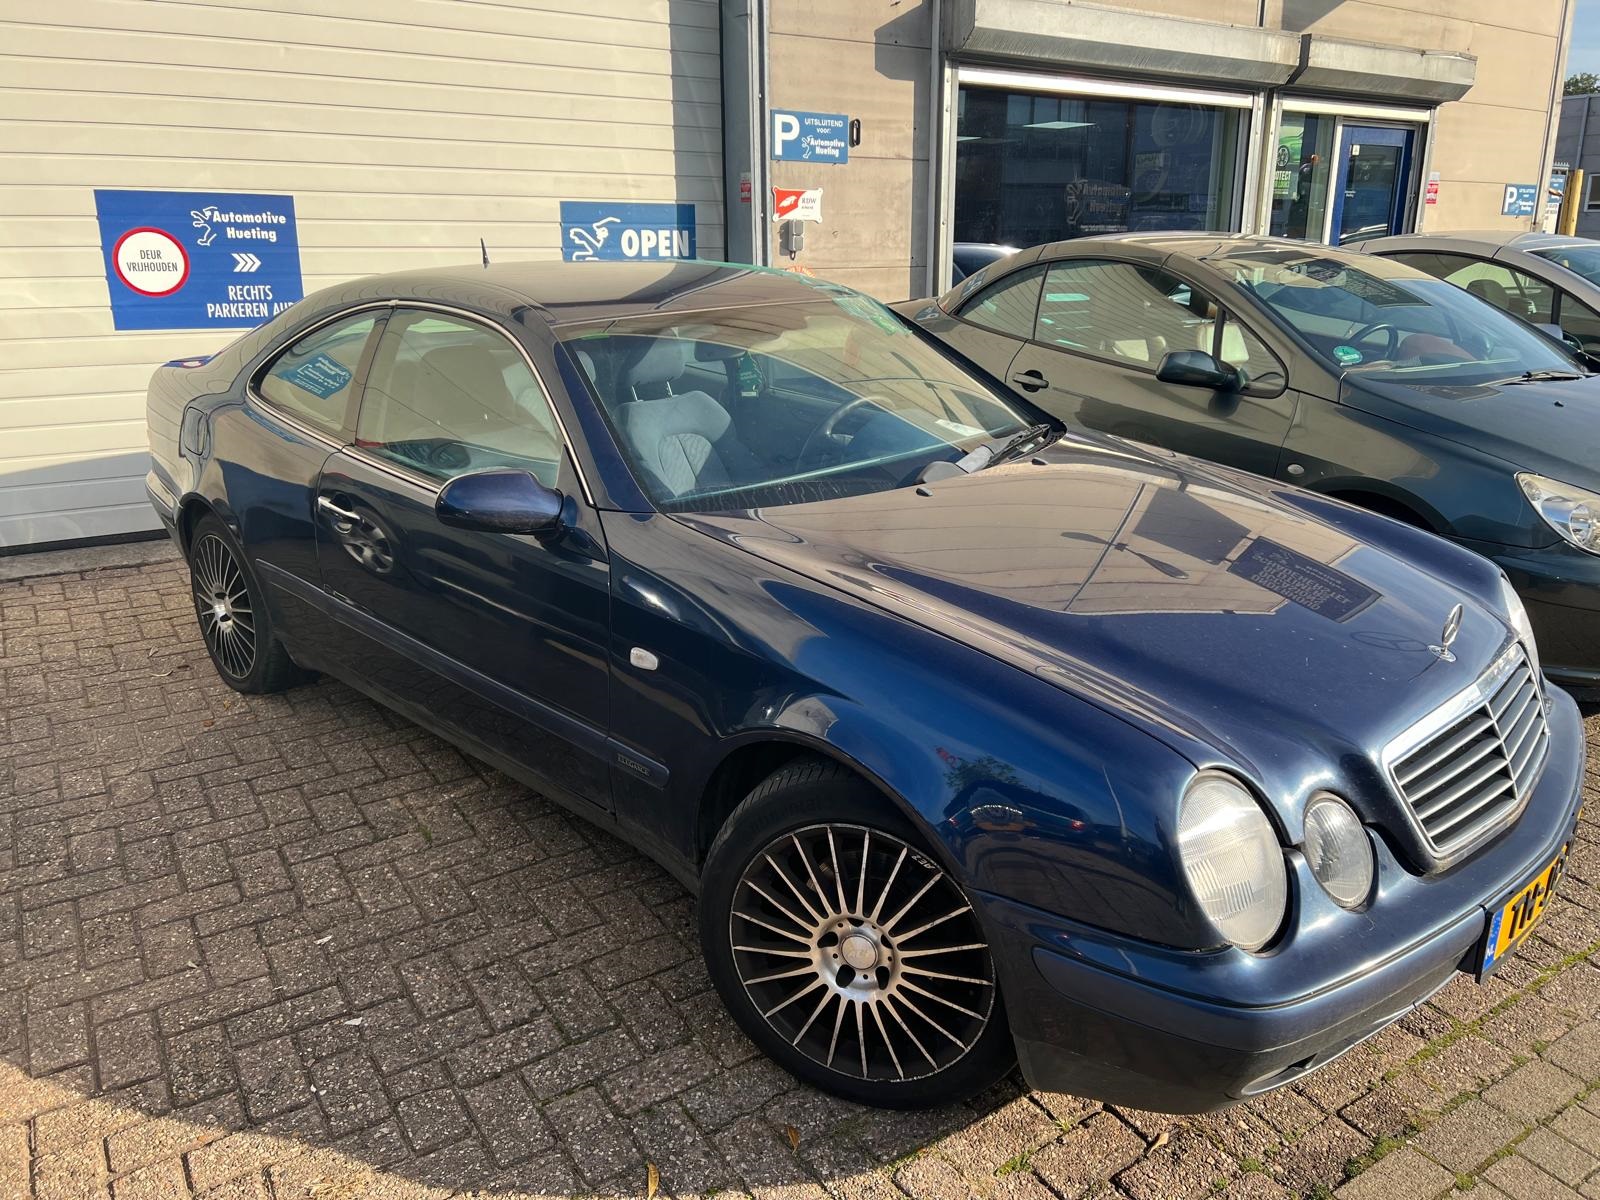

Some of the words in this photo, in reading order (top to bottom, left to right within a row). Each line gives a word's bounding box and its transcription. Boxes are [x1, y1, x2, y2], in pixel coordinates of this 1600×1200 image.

[804, 117, 844, 128] UITSLUITEND
[774, 113, 800, 156] P
[810, 138, 845, 148] Automotive
[815, 146, 840, 158] Hueting
[1504, 186, 1517, 212] P
[212, 211, 287, 224] Automotive
[226, 227, 277, 242] Hueting
[621, 229, 689, 257] OPEN
[139, 249, 162, 260] DEUR
[126, 261, 178, 272] VRIJHOUDEN
[228, 285, 273, 300] RECHTS
[207, 302, 268, 318] PARKEREN
